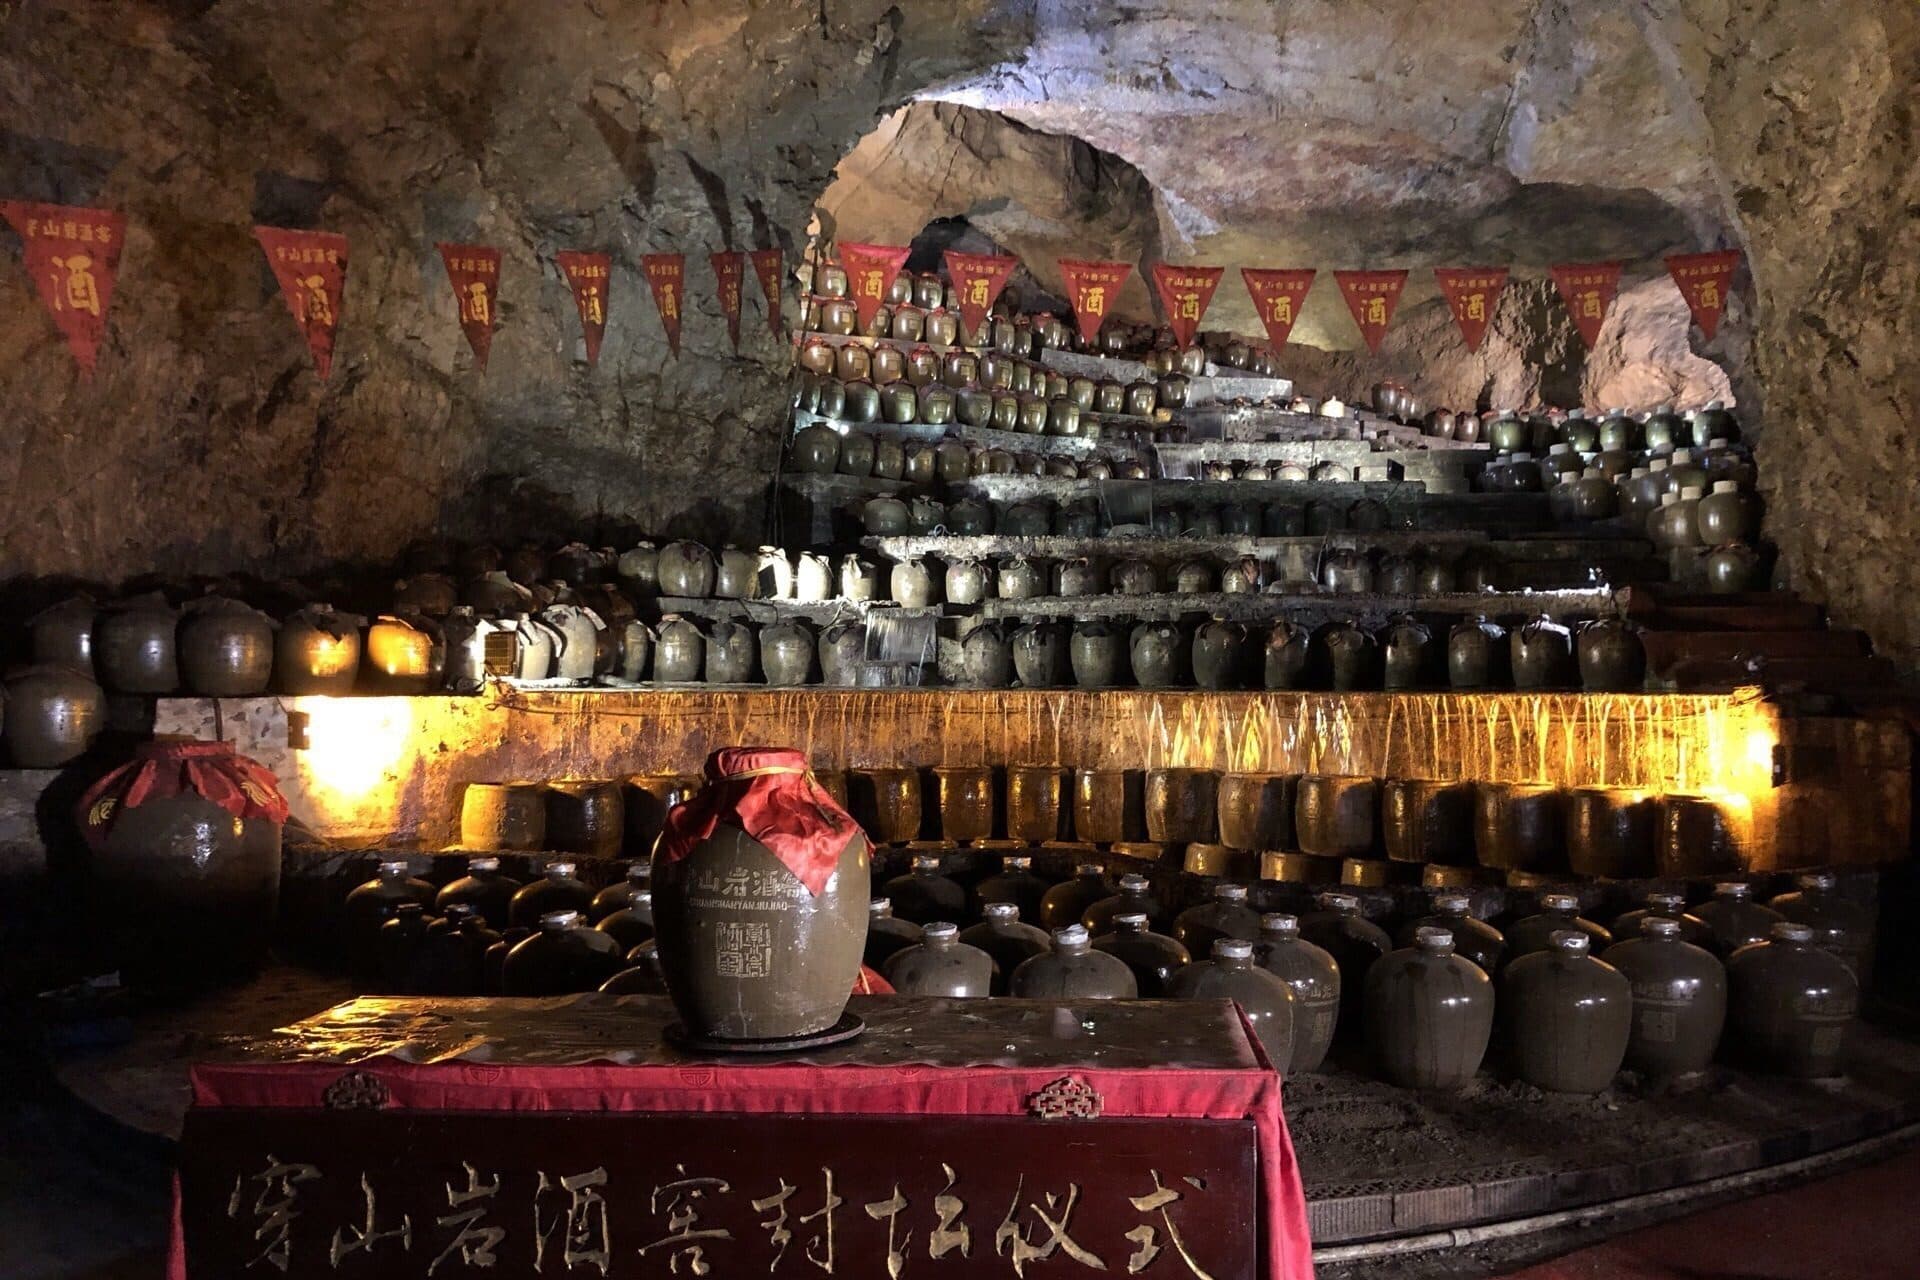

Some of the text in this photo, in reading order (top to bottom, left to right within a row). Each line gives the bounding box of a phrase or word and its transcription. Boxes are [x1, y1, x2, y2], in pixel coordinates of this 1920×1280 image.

[49, 254, 101, 317] 酒
[295, 274, 333, 326] 酒
[856, 270, 884, 300] 酒
[962, 278, 990, 309] 酒
[1691, 279, 1720, 310] 酒
[460, 281, 489, 326] 酒
[581, 286, 602, 325] 酒
[658, 282, 678, 320] 酒
[1077, 286, 1105, 317] 酒
[1173, 292, 1200, 322] 酒
[1266, 295, 1292, 325] 酒
[1359, 296, 1387, 326] 酒
[1458, 293, 1485, 323] 酒
[1573, 290, 1602, 320] 酒
[682, 866, 803, 898] 山岩酒窖
